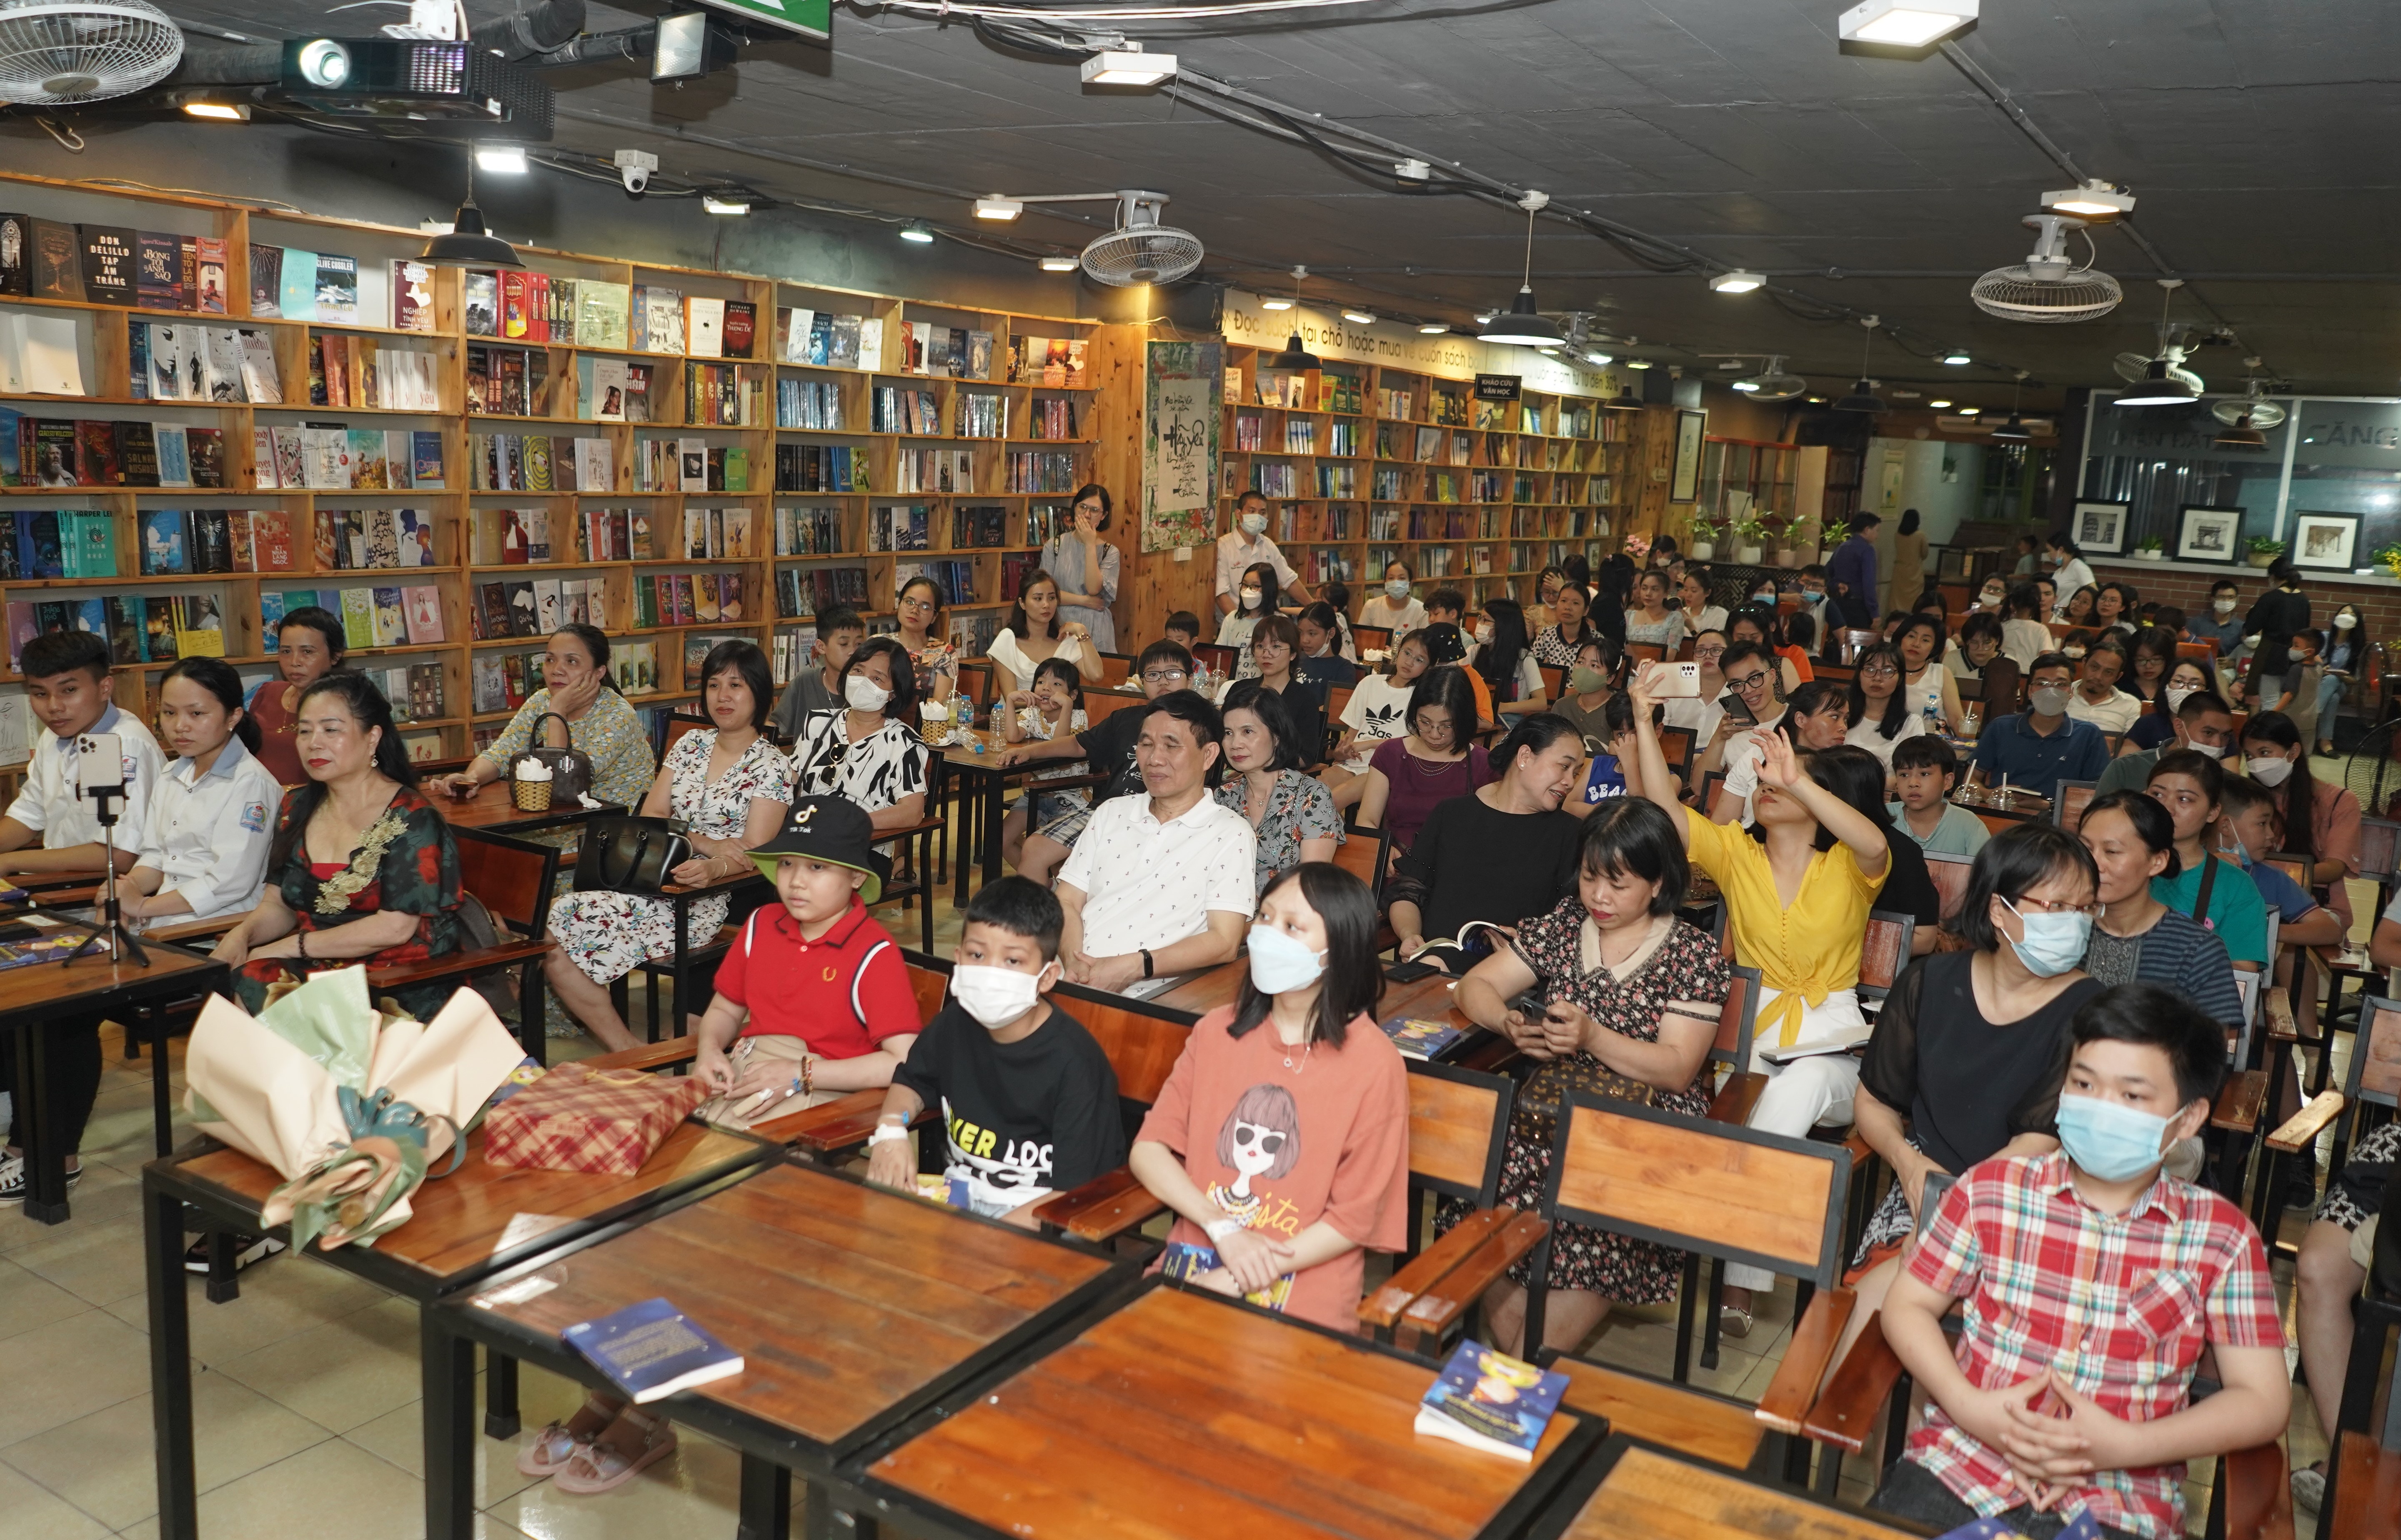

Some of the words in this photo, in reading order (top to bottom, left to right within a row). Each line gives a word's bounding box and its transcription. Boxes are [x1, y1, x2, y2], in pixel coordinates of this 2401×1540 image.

[99, 235, 120, 245] DON
[90, 245, 130, 257] DELILLO
[317, 259, 331, 269] CLIVE
[331, 261, 354, 272] CUSSLER
[1233, 308, 1260, 338] Đọc
[1321, 321, 1343, 348] chỗ
[1347, 329, 1375, 356] hoặc
[1379, 340, 1401, 357] mua
[1418, 340, 1442, 364] cuốn
[1444, 344, 1466, 368] sách
[242, 338, 270, 351] HANNIBAL
[1481, 377, 1499, 386] KHẢO
[1499, 378, 1514, 387] CỨU
[1483, 387, 1497, 396] VĂN
[1497, 388, 1511, 398] HỌC
[254, 430, 268, 440] oody
